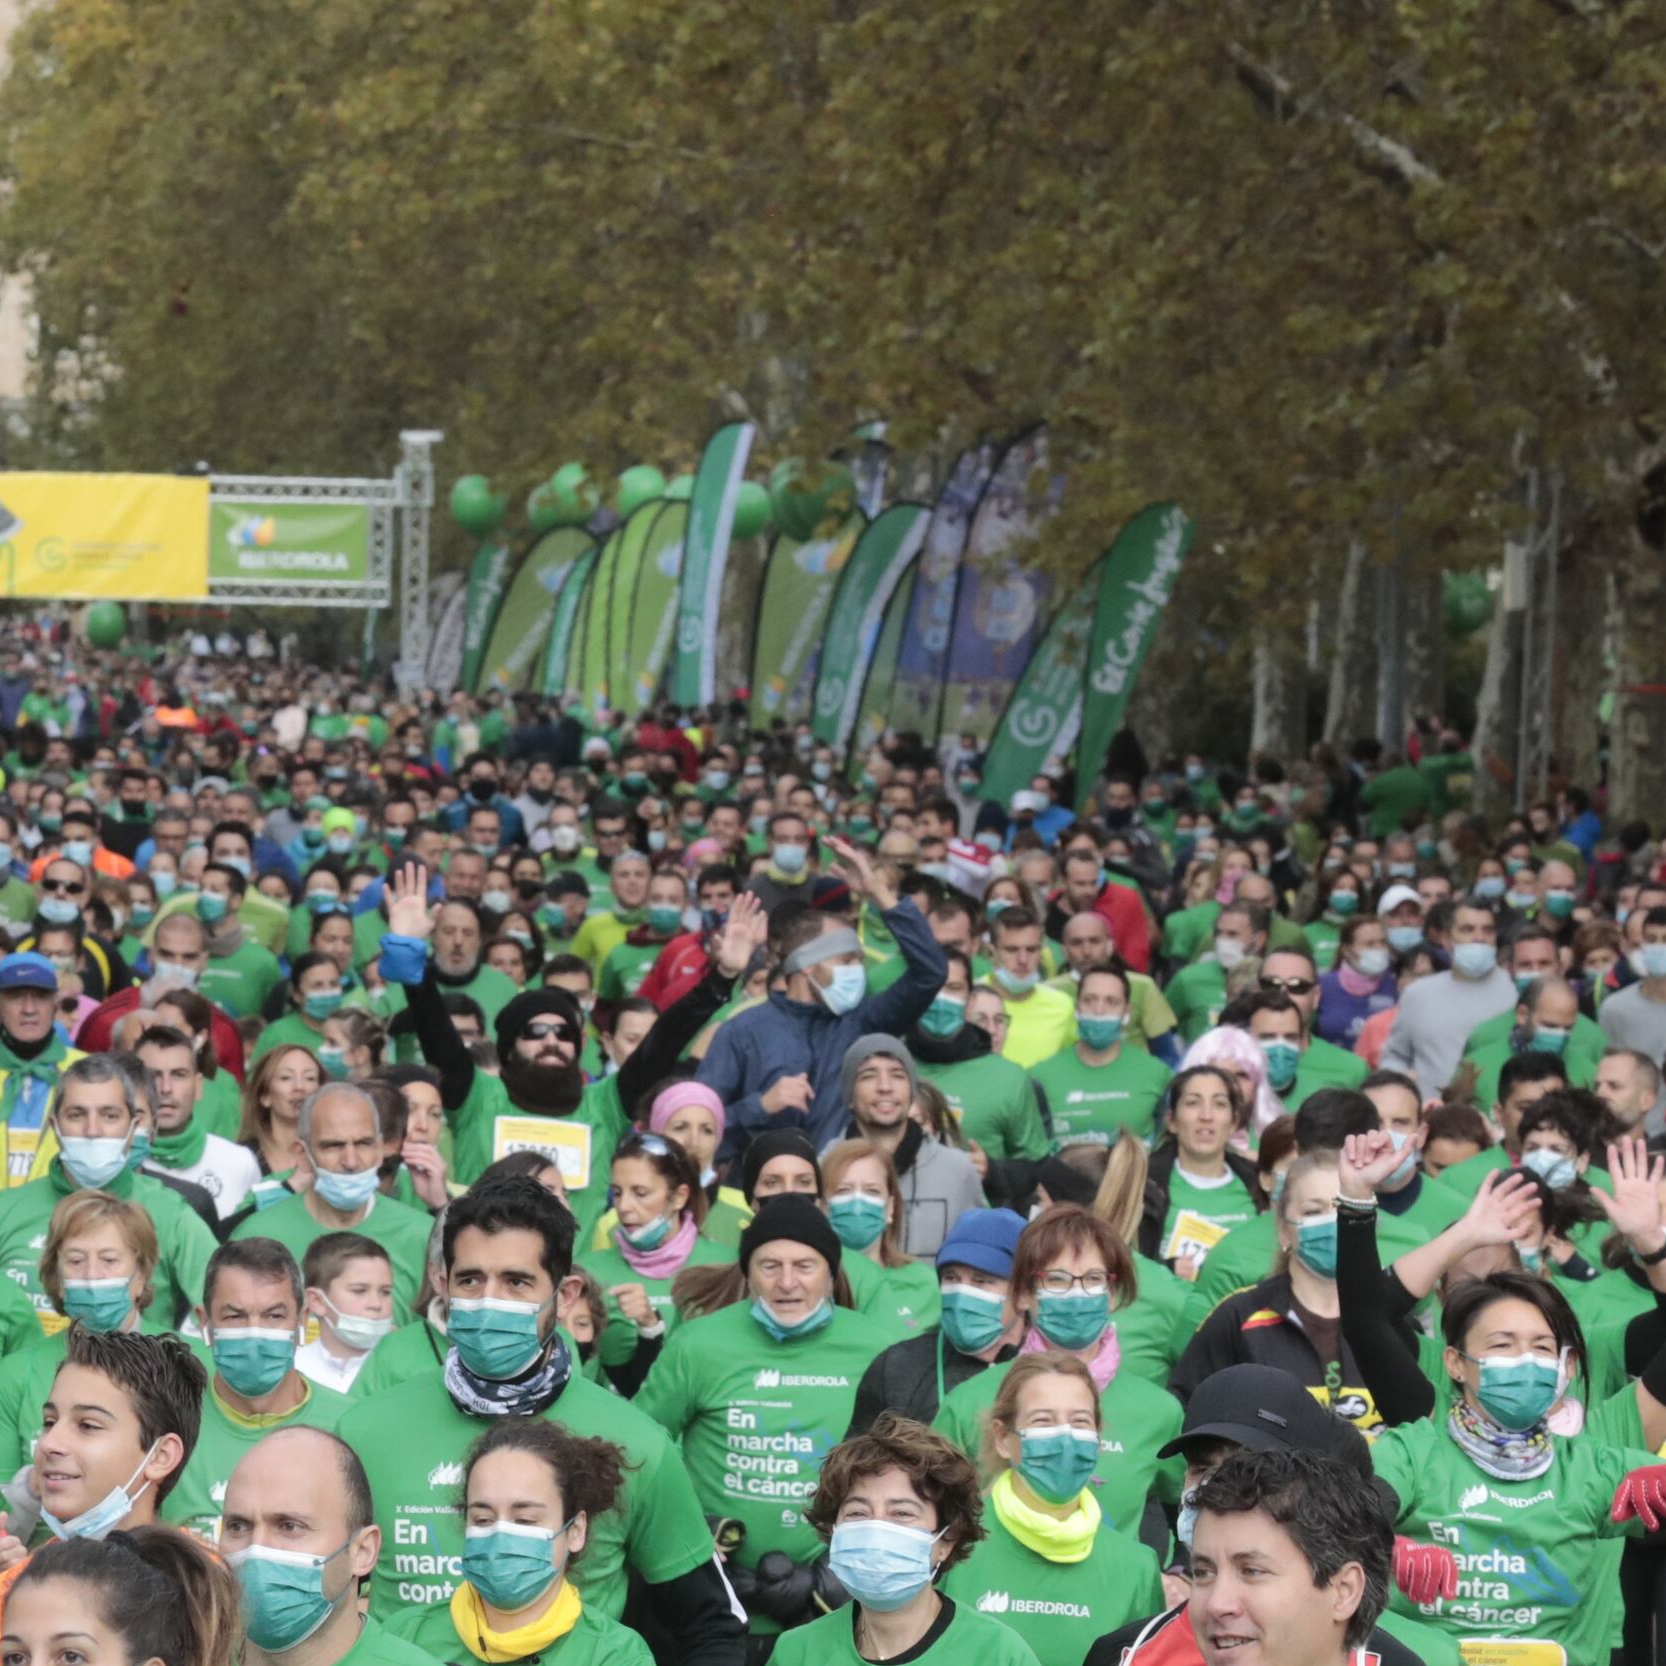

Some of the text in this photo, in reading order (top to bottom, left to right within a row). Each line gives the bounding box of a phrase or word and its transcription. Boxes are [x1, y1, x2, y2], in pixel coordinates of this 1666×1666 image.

[238, 551, 350, 571] IBERDROLA
[781, 1374, 849, 1388] IBERDROLA
[727, 1407, 756, 1430] En
[727, 1431, 813, 1454] marcha
[726, 1453, 799, 1475] contra
[723, 1471, 744, 1494] el
[1427, 1521, 1460, 1546] En
[1011, 1597, 1091, 1619] IBERDROLA
[1418, 1600, 1545, 1627] el cáncer
